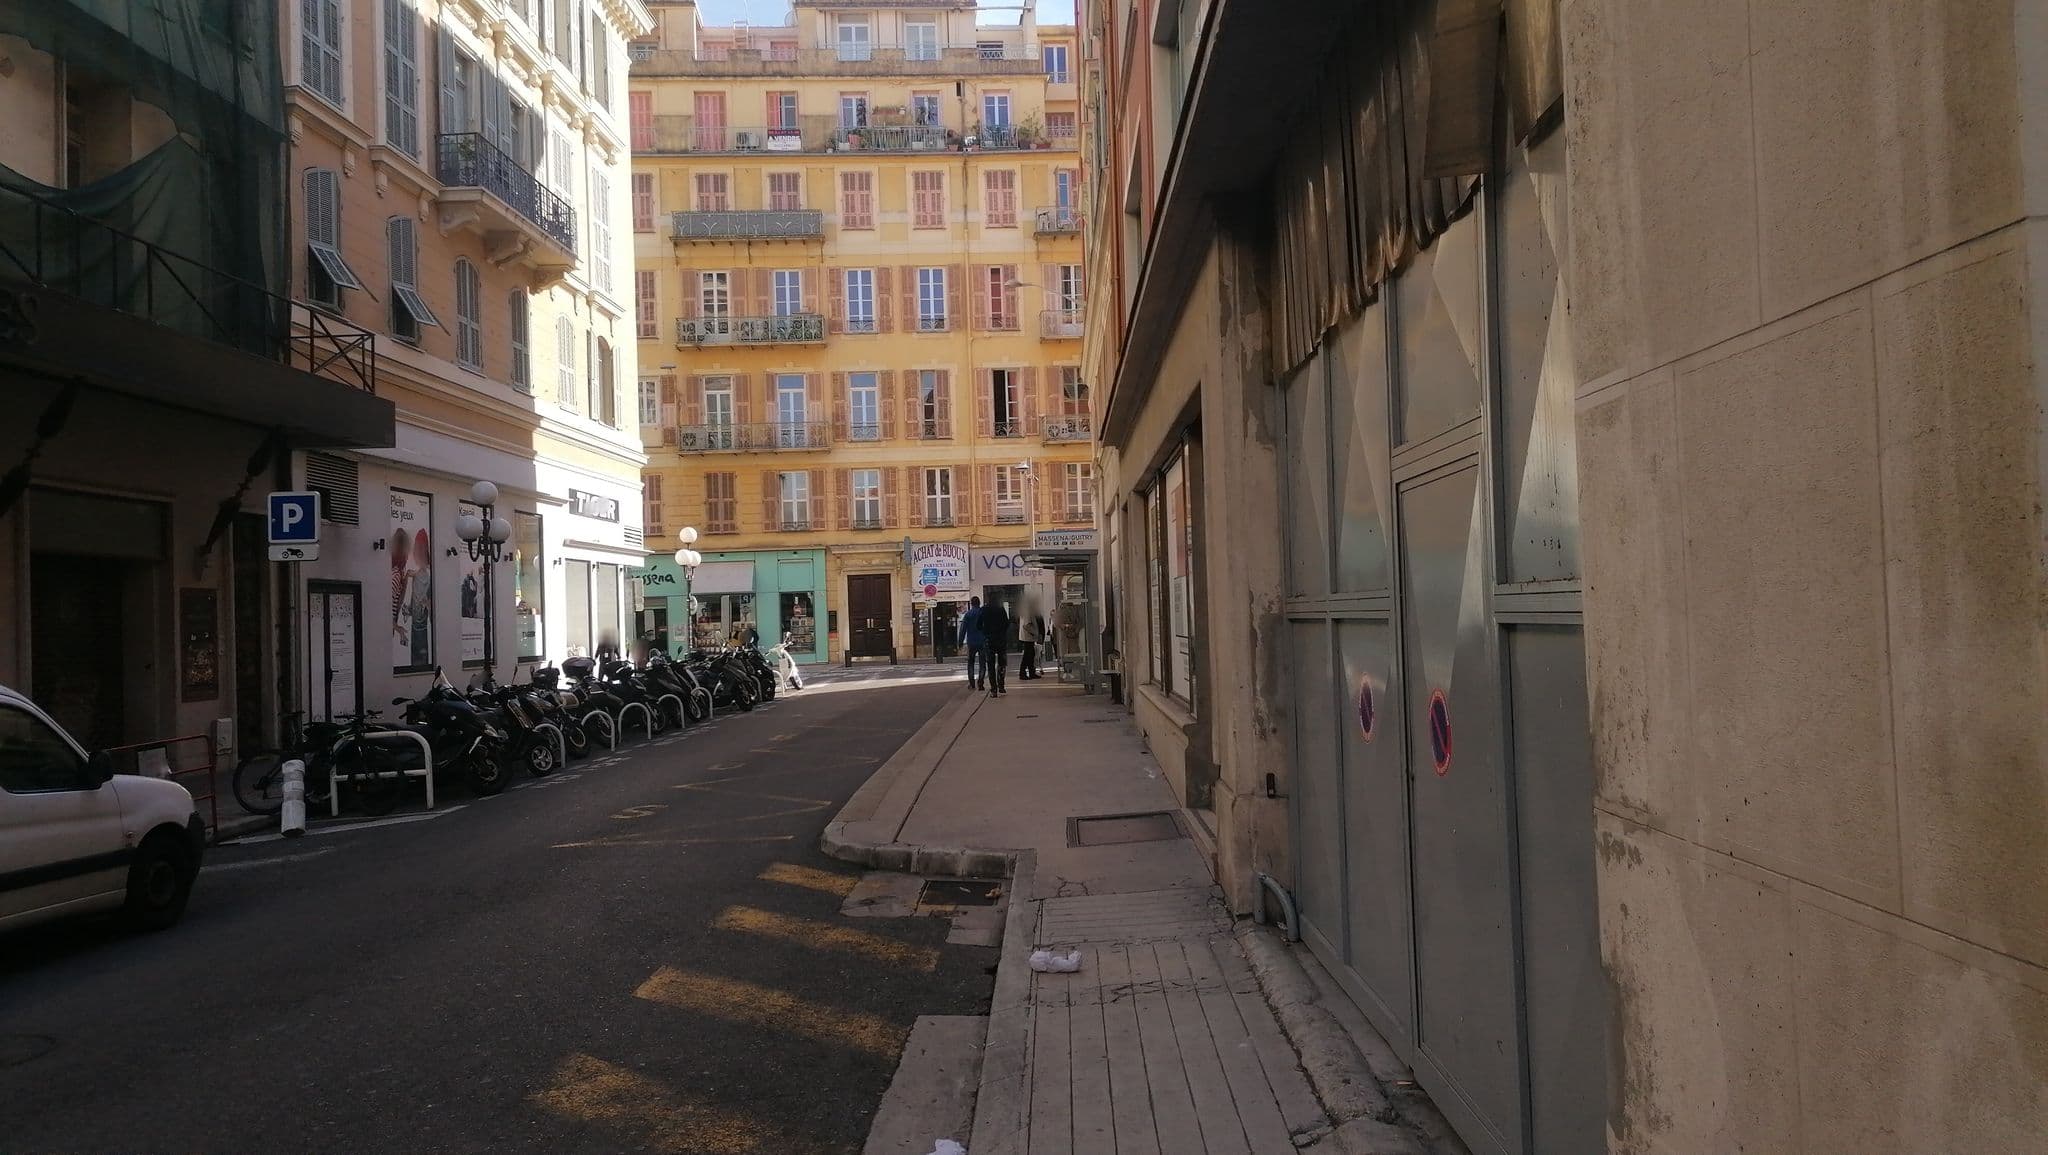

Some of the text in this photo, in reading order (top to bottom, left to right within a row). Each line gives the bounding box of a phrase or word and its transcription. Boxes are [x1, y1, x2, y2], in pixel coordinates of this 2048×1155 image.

[282, 503, 304, 532] P
[576, 491, 616, 520] TIGR
[913, 543, 967, 564] ACHAT de BIJOUX
[632, 565, 676, 585] sséna
